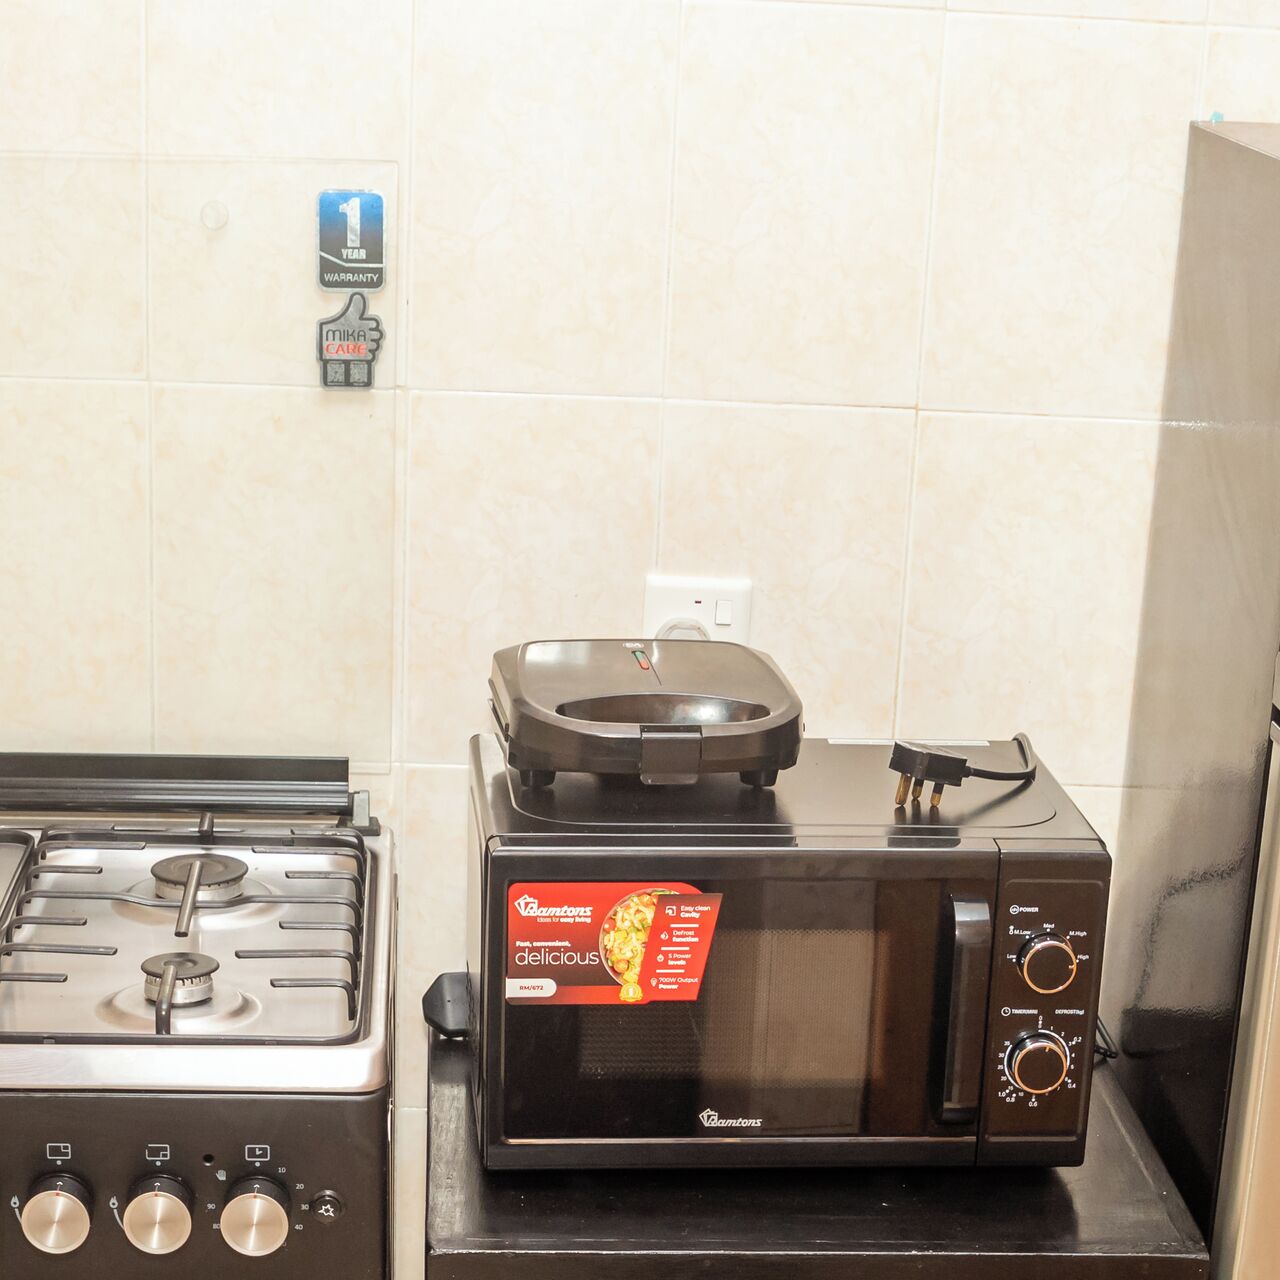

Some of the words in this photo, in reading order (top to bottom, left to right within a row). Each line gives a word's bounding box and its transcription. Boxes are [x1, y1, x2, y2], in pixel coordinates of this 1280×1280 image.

[339, 197, 360, 247] 1
[342, 249, 366, 260] YEAR
[324, 273, 379, 283] WARRANTY
[326, 329, 367, 342] MIKA
[325, 343, 367, 356] CARE
[519, 899, 593, 916] Ramtons
[575, 916, 592, 924] living
[533, 940, 572, 948] convenient,
[515, 948, 599, 966] delicious
[703, 1112, 762, 1127] Ramtons
